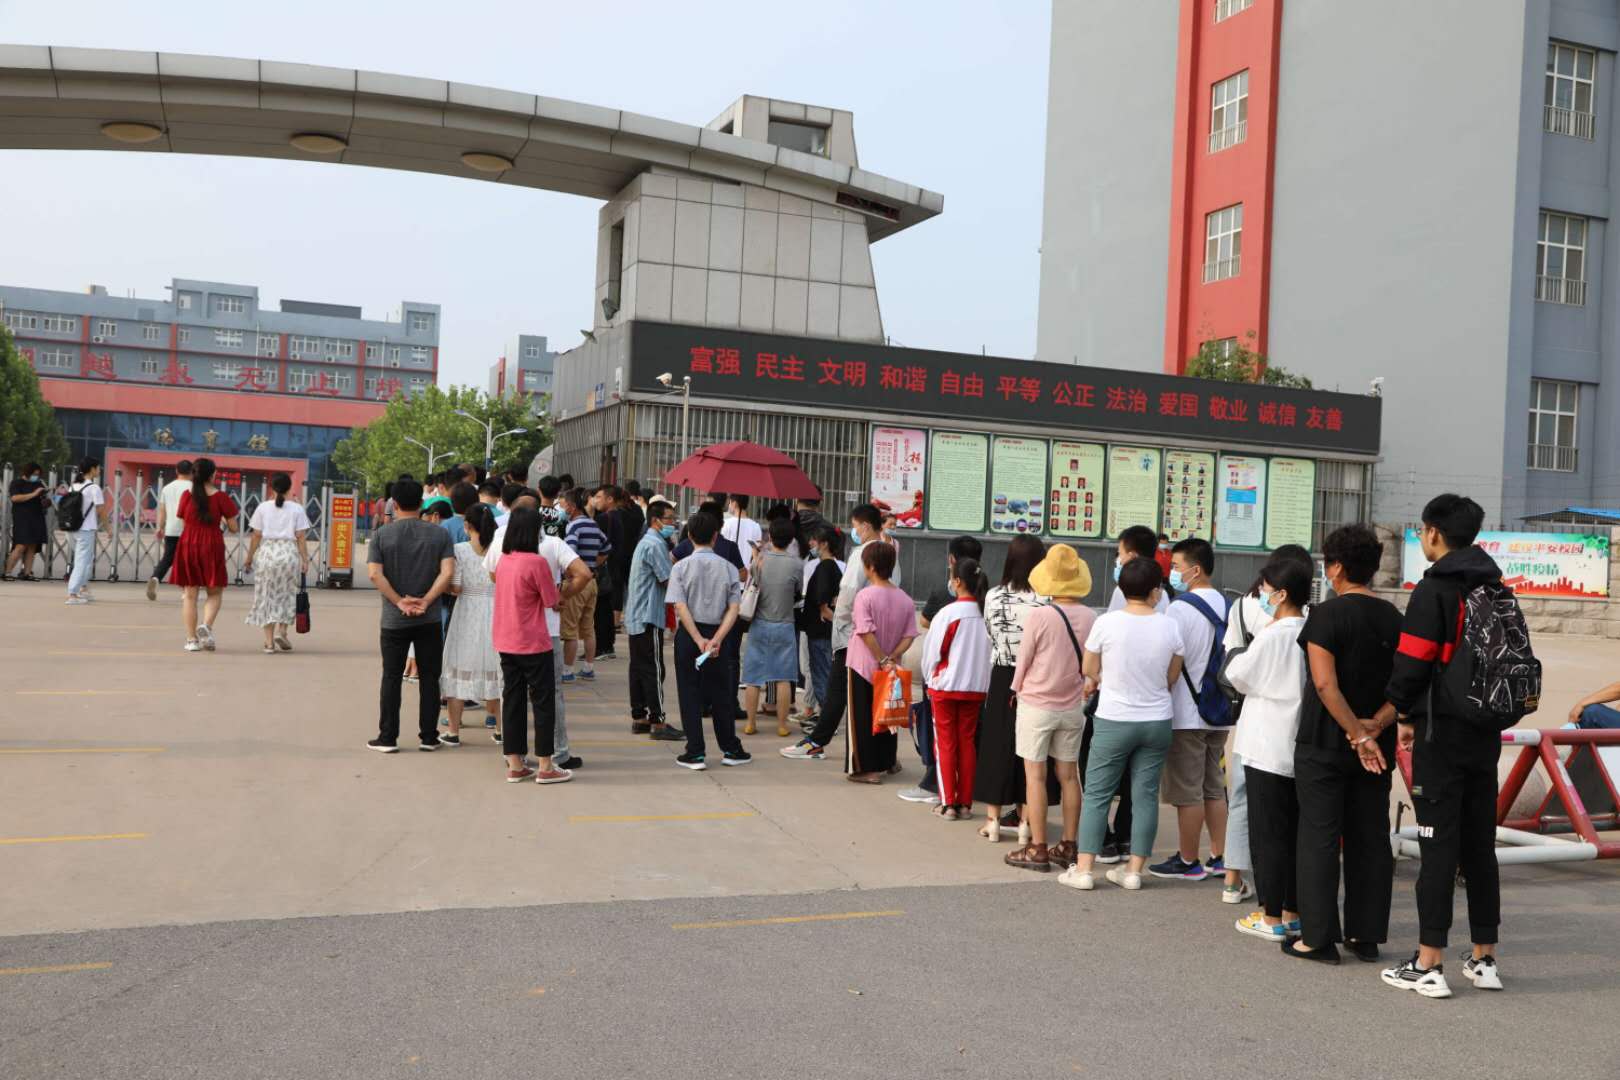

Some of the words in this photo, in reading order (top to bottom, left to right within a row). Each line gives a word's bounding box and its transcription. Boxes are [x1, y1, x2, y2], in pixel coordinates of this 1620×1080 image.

[690, 346, 740, 375] 富强
[755, 352, 805, 381] 民主
[817, 358, 866, 387] 文明
[880, 364, 928, 392] 和谐
[941, 369, 984, 398] 自由
[996, 376, 1041, 403] 平等
[1052, 381, 1096, 407] 公正
[1105, 386, 1148, 414] 法治
[1159, 392, 1199, 418] 爱国
[1209, 394, 1248, 422] 敬业
[1258, 400, 1297, 426] 诚信
[1305, 406, 1343, 432] 友善
